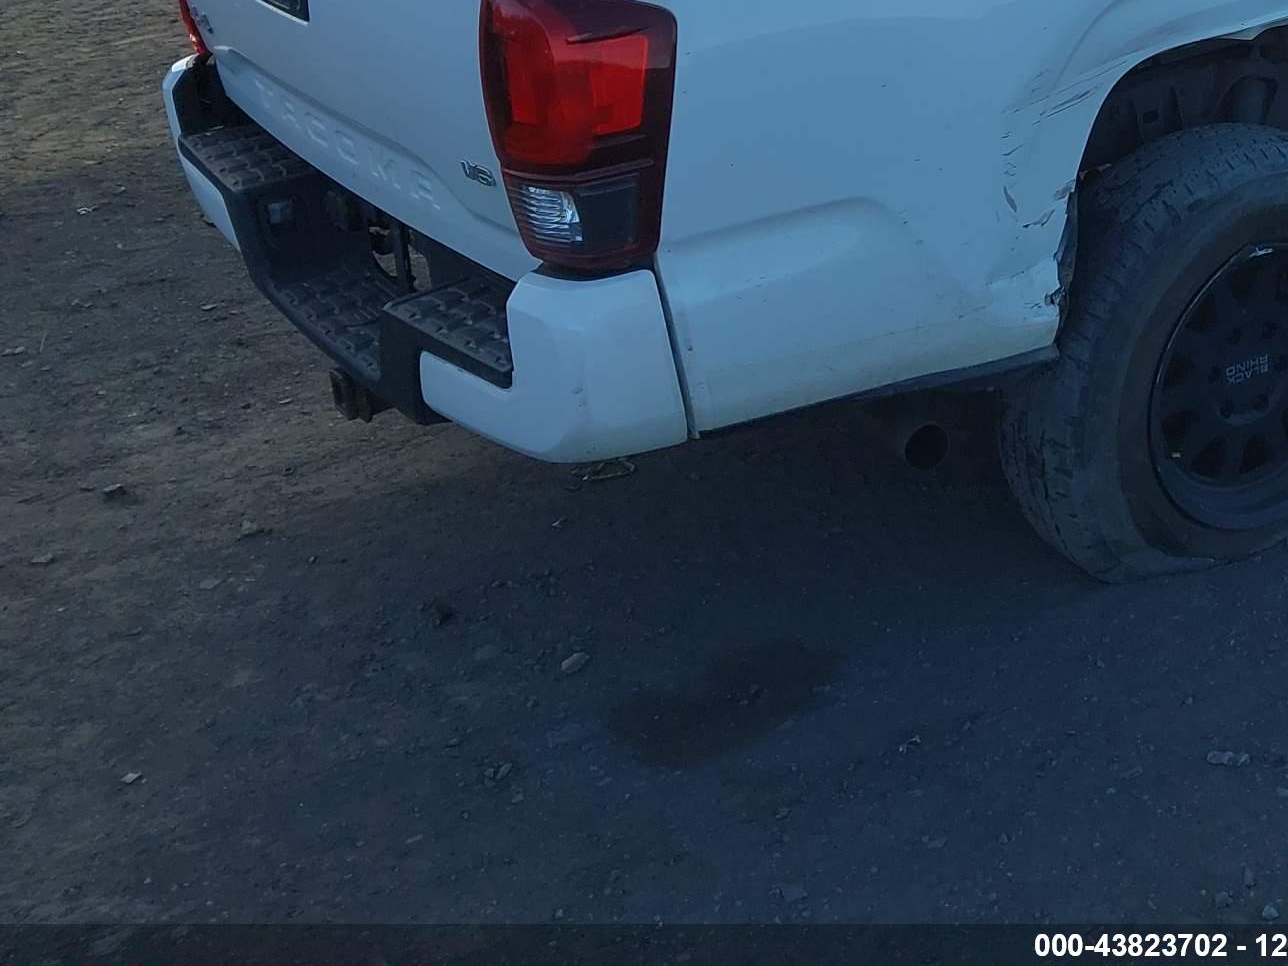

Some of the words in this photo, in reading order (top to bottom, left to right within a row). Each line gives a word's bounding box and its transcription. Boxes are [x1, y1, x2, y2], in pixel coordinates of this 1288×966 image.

[460, 157, 497, 187] V6
[1225, 353, 1269, 376] RHINO
[1225, 363, 1269, 385] BLACK
